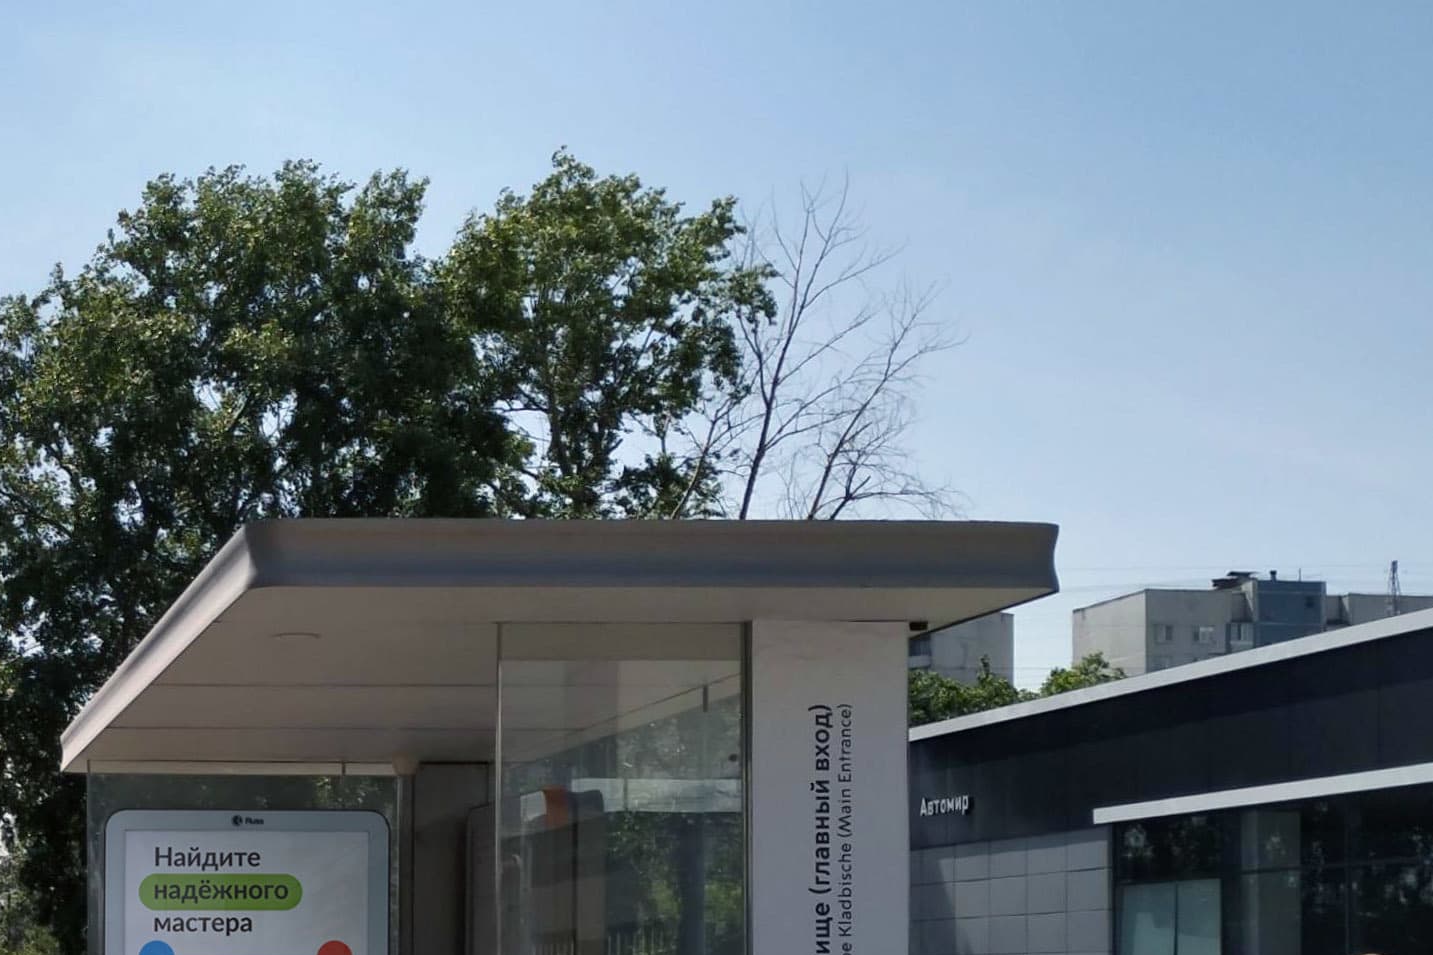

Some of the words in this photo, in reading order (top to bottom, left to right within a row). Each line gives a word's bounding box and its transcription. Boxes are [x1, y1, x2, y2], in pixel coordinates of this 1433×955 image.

[808, 704, 832, 770] вход)
[838, 703, 854, 782] Entrance)
[838, 788, 854, 838] (Main
[919, 794, 969, 816] Автомир
[155, 847, 261, 871] Найдите
[809, 780, 833, 894] (главный
[154, 880, 289, 903] надёжного
[838, 843, 853, 937] Kladbische
[154, 915, 253, 935] мастера
